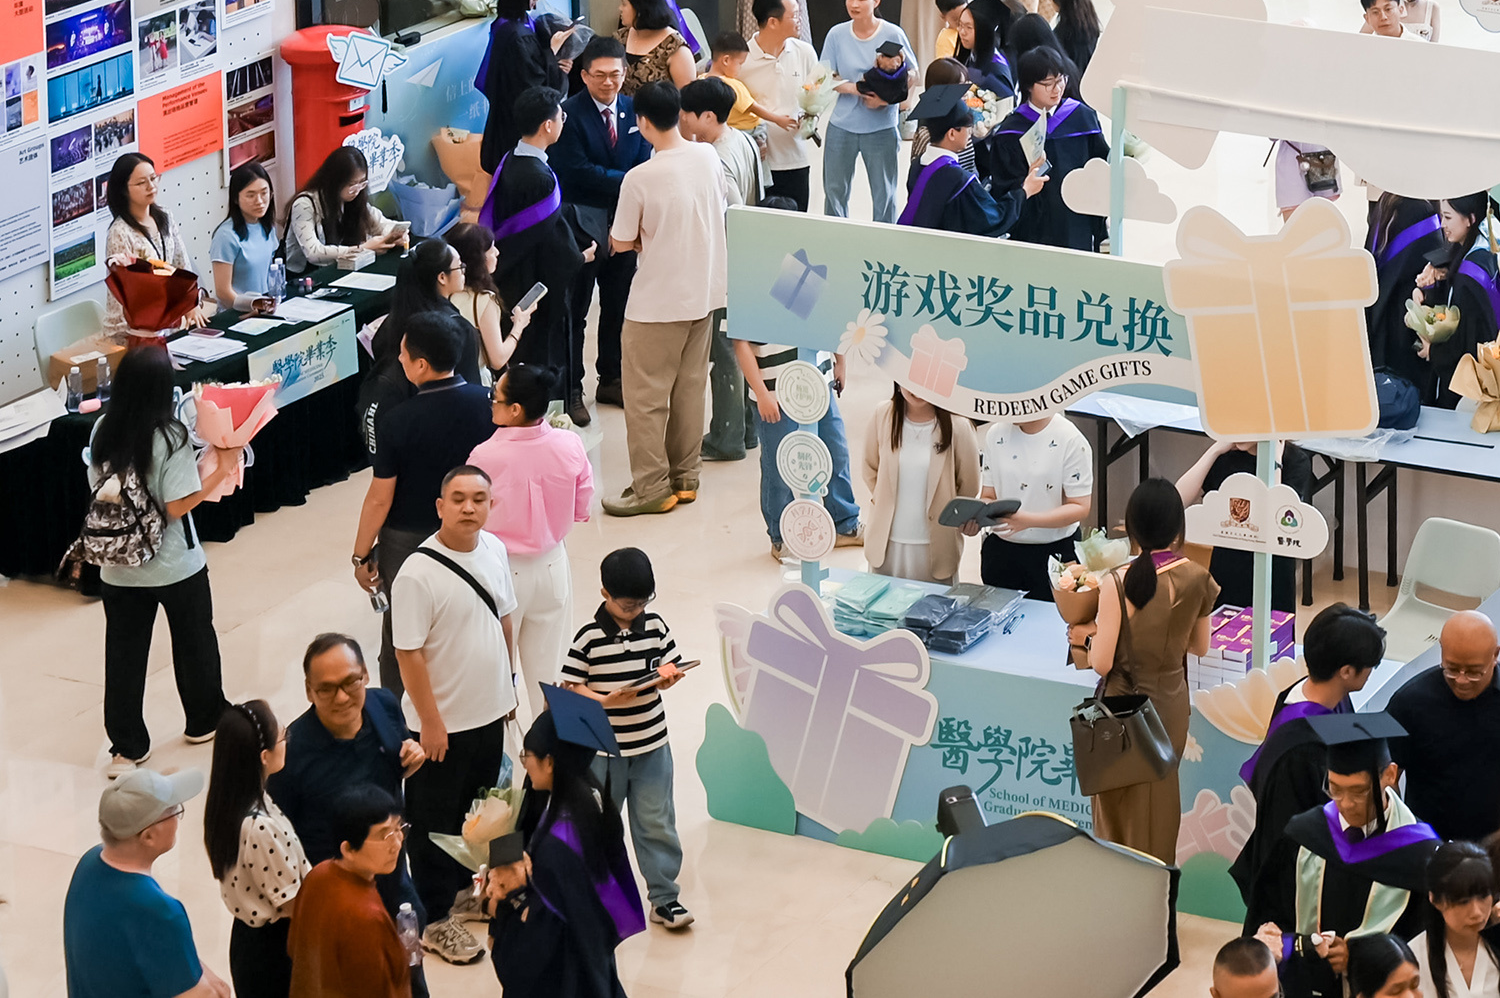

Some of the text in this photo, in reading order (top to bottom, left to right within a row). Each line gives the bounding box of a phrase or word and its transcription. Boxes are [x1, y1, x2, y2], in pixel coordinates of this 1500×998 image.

[860, 259, 1173, 357] 游戏奖品兑换
[974, 359, 1153, 417] REDEEM GAME GIFTS
[989, 787, 1029, 805] School
[1032, 796, 1046, 807] of
